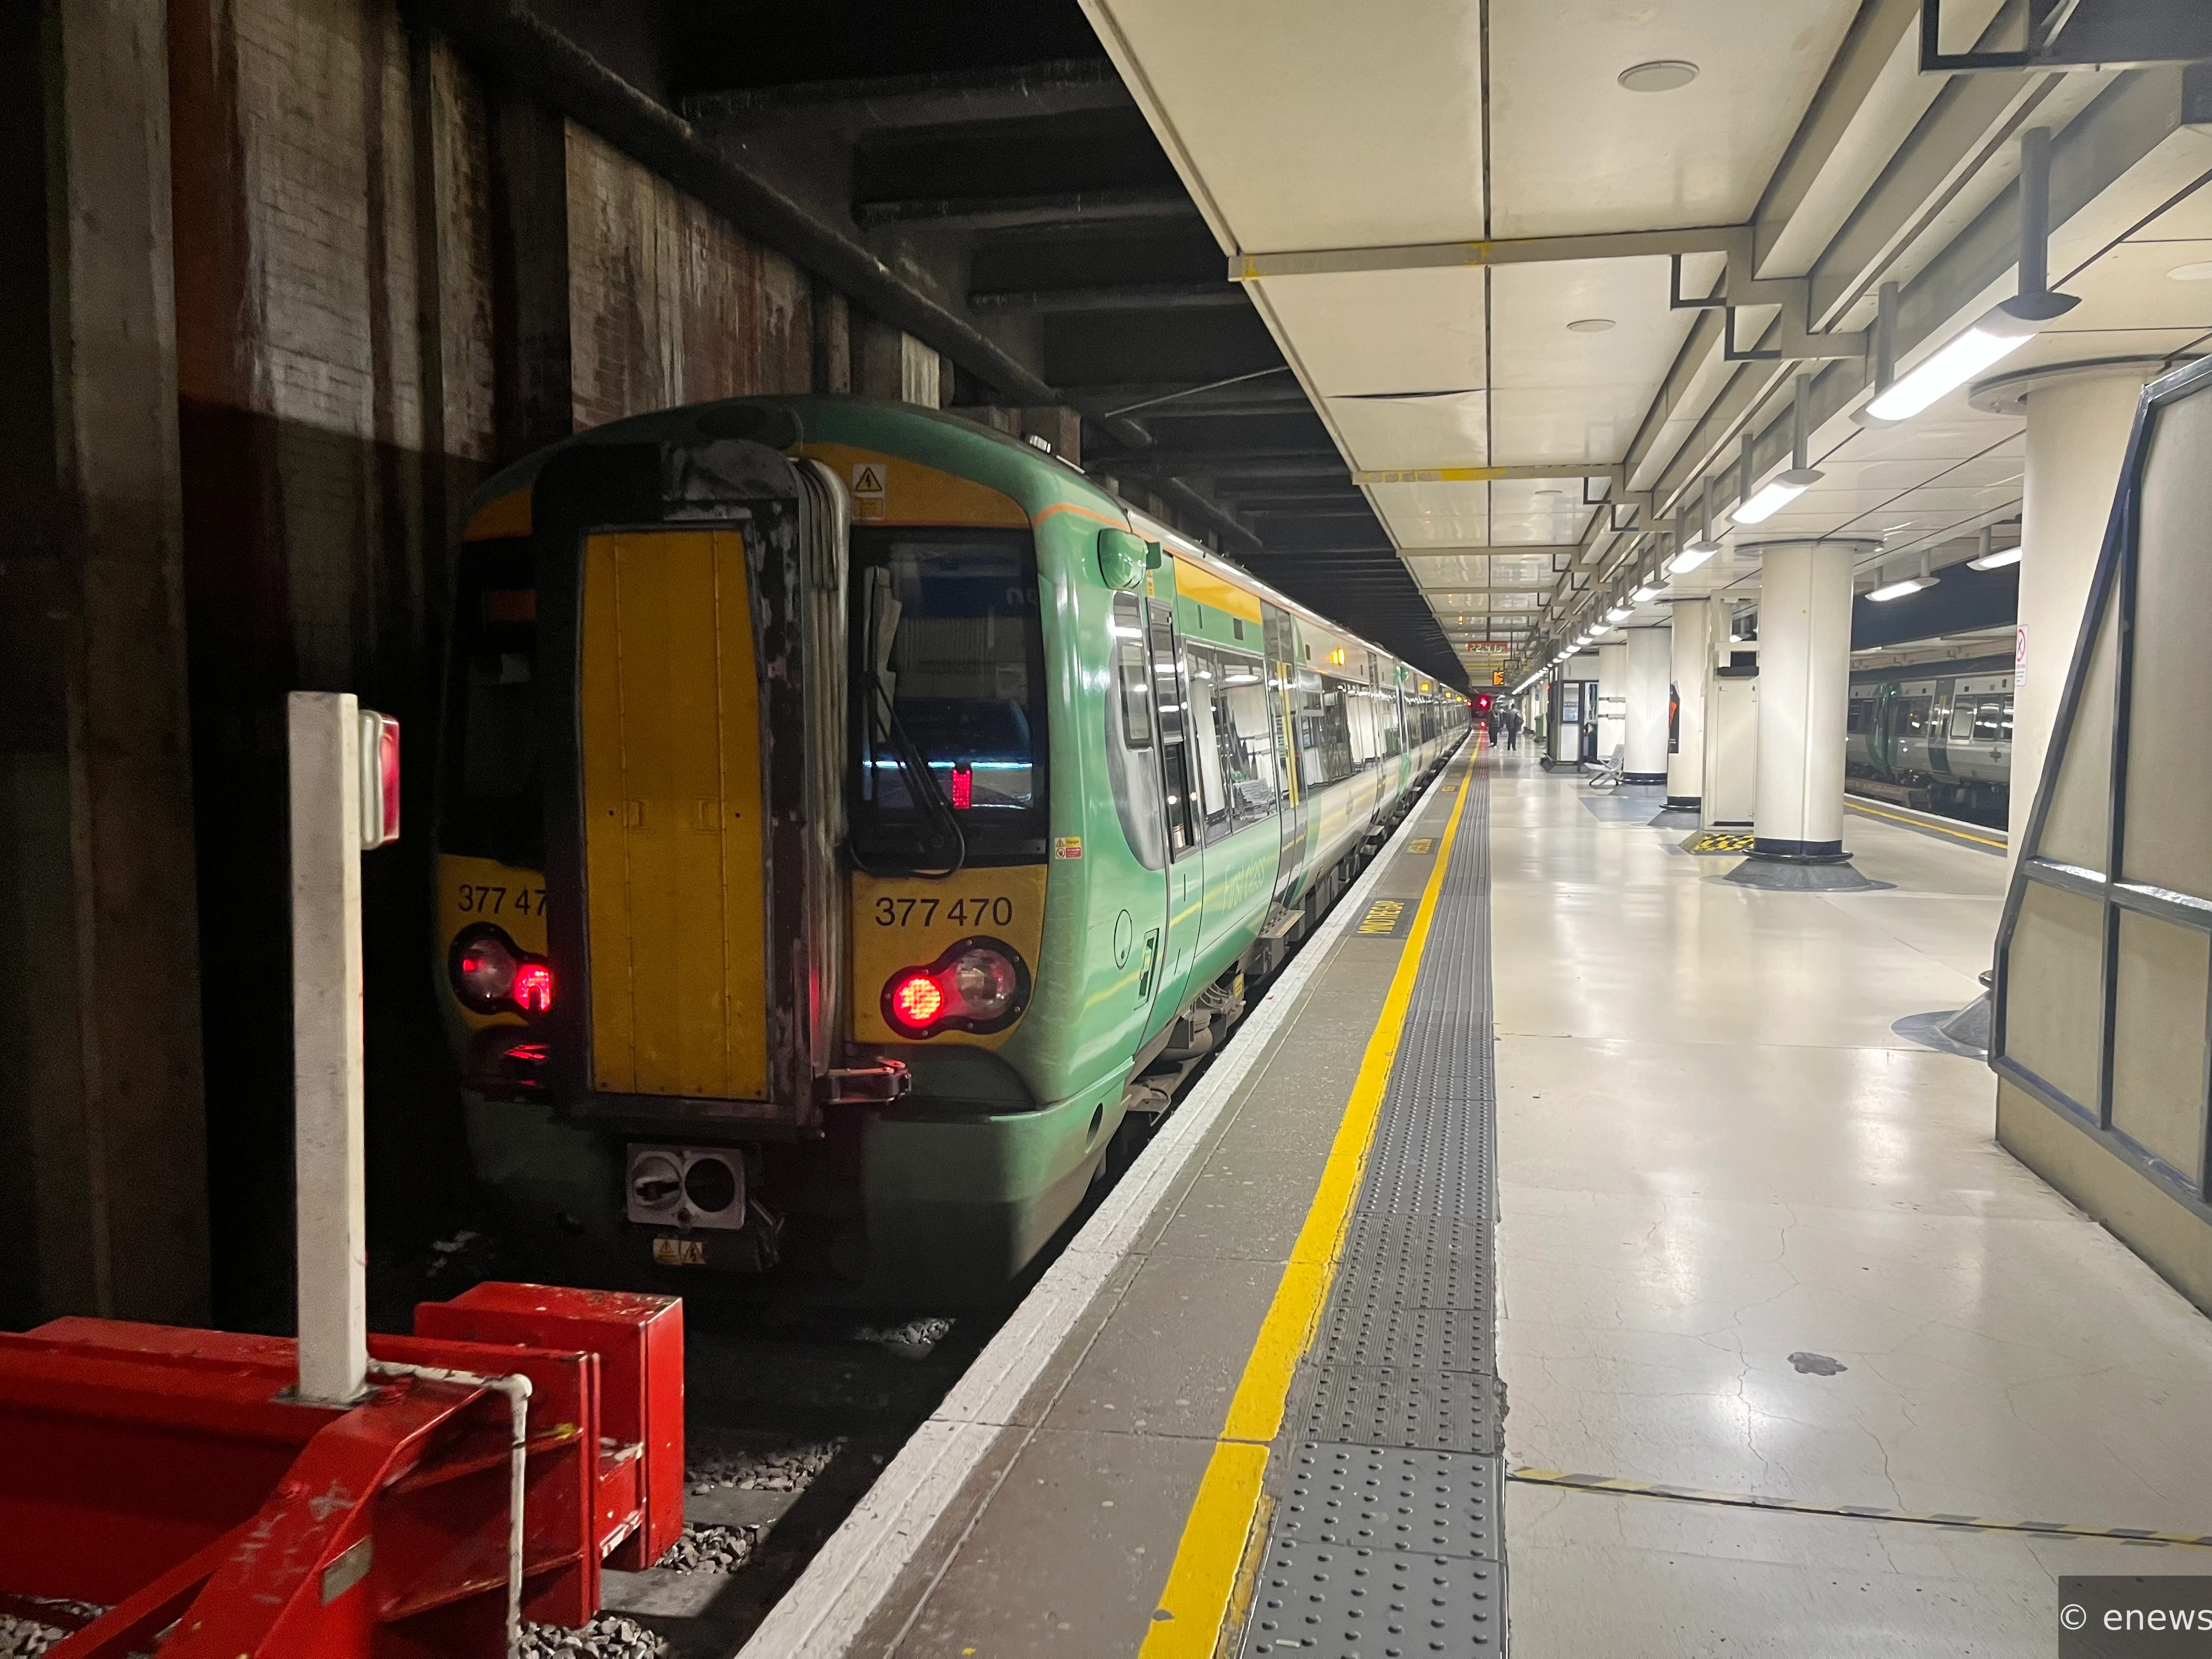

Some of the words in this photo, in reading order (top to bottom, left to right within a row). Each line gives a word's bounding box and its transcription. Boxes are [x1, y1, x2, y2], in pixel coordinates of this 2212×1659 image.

[459, 884, 507, 913] 377
[875, 897, 940, 927] 377
[947, 896, 1013, 927] 470
